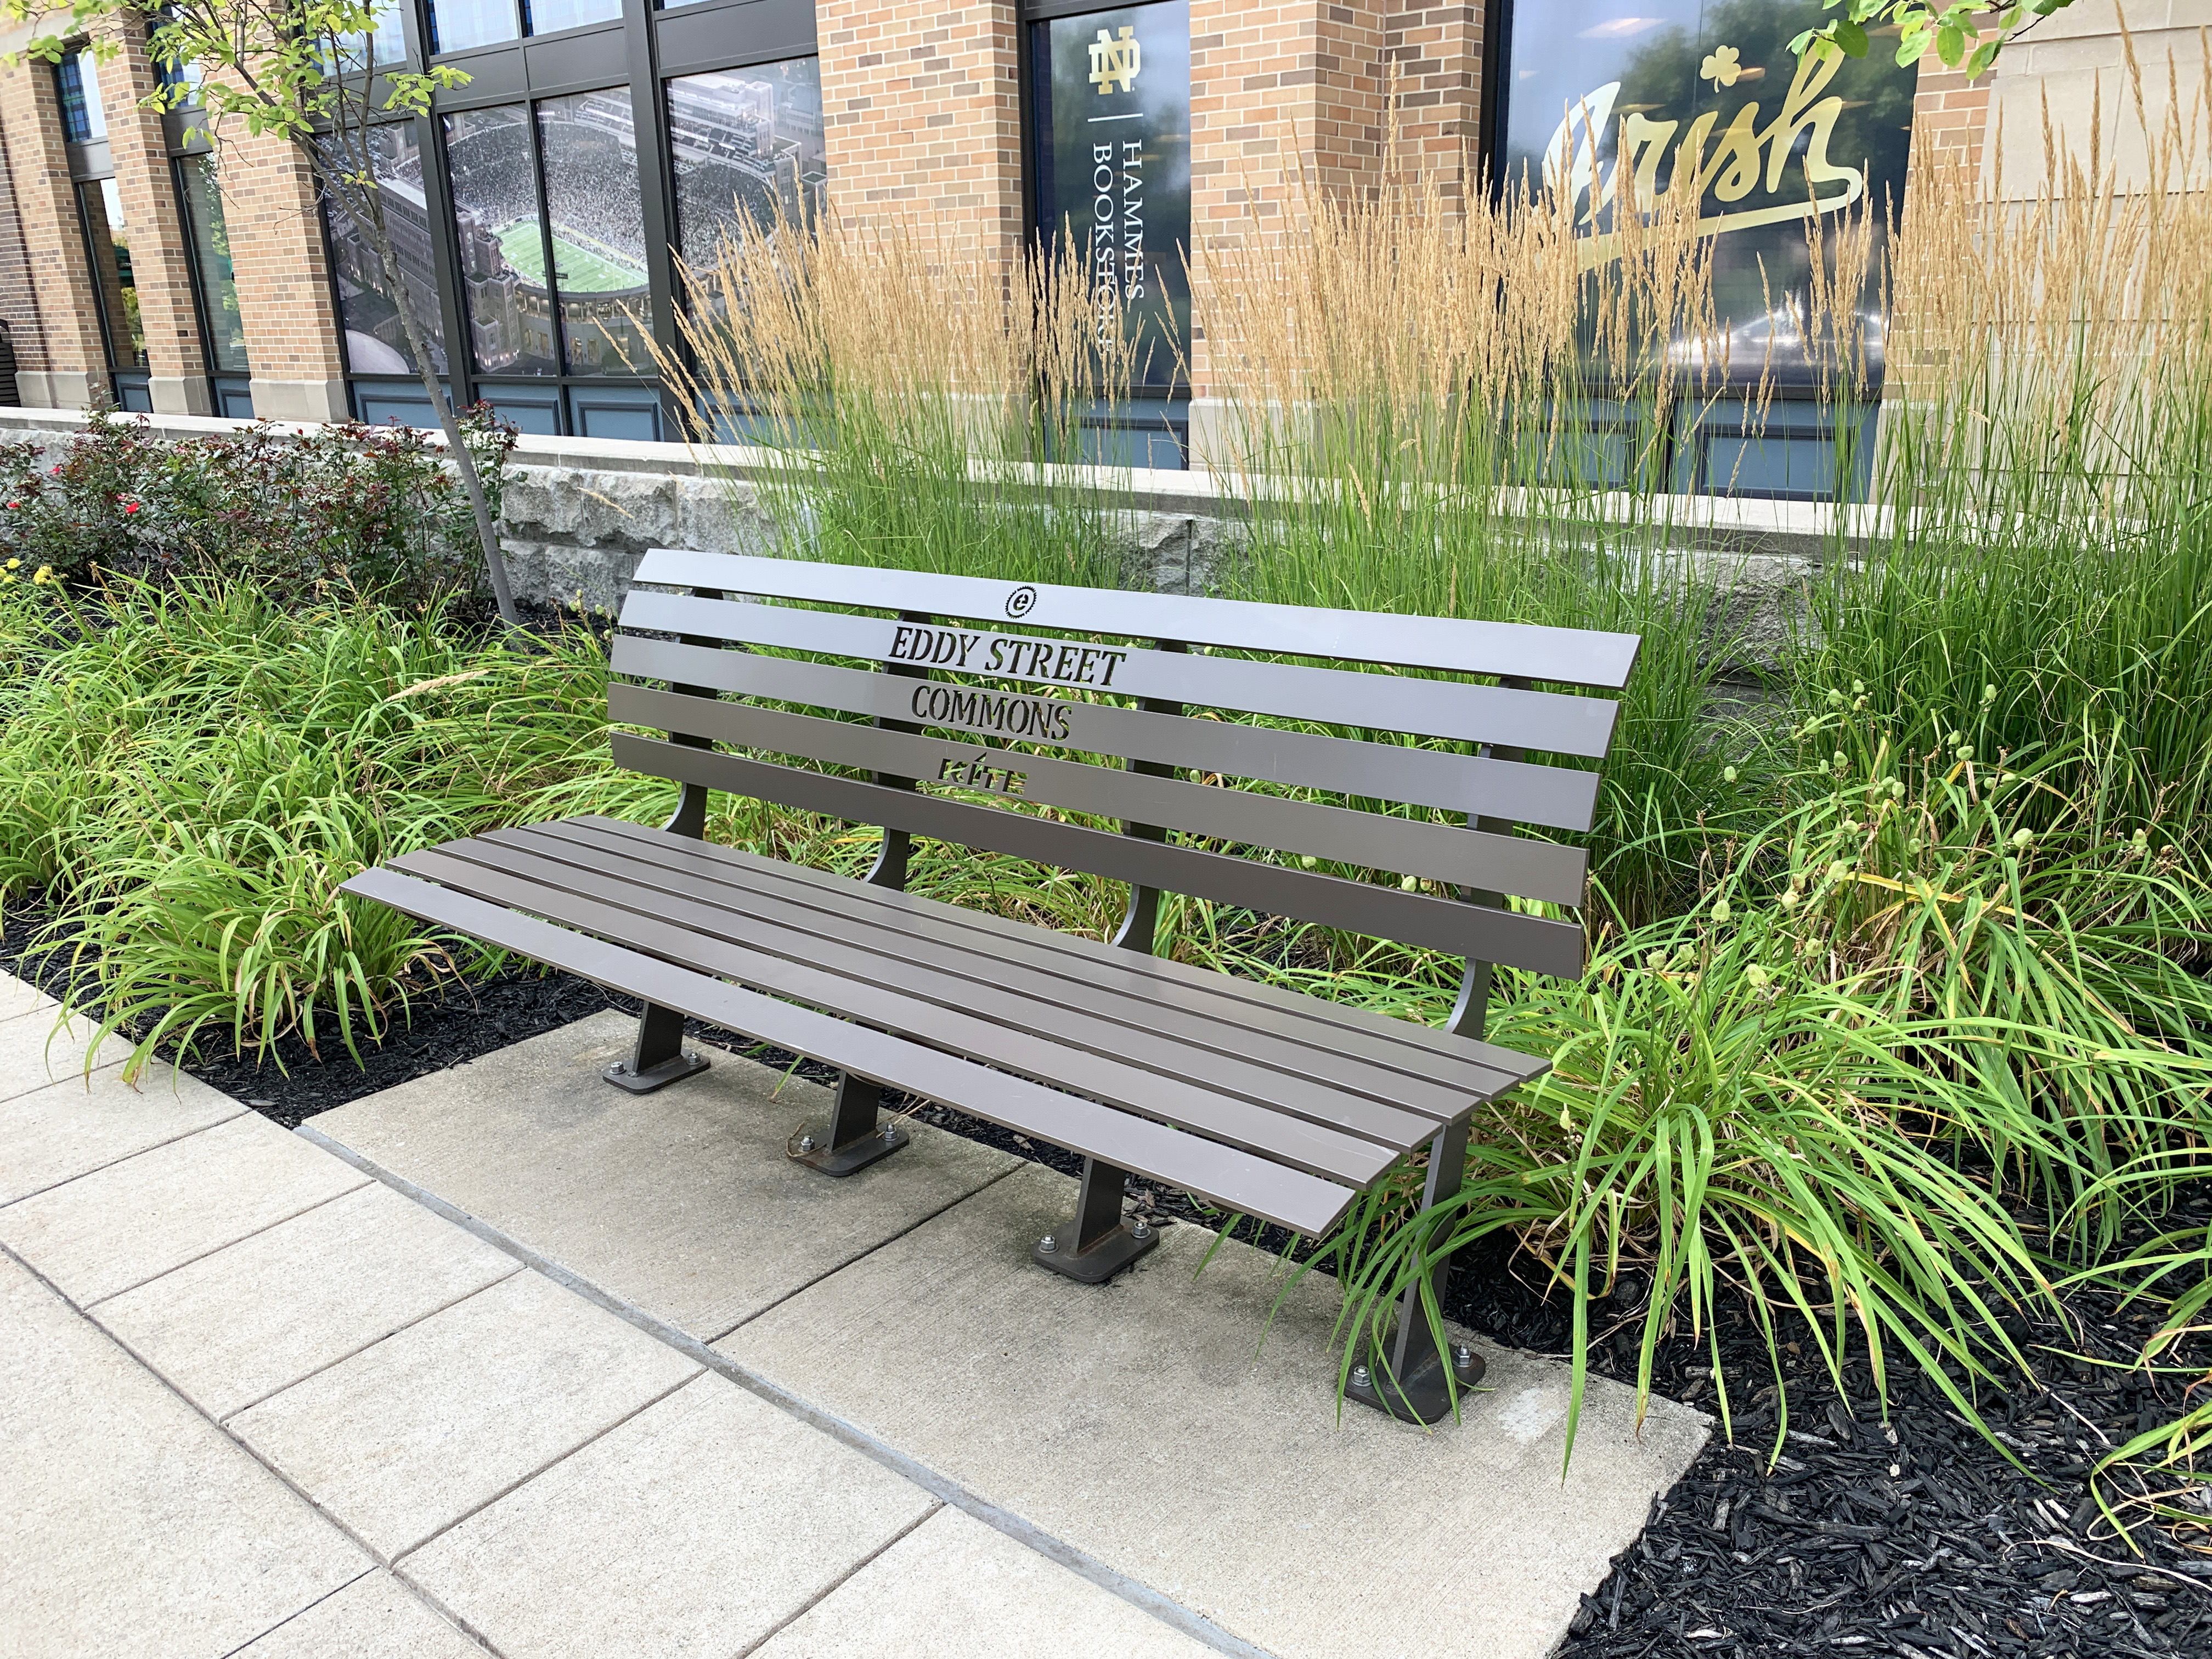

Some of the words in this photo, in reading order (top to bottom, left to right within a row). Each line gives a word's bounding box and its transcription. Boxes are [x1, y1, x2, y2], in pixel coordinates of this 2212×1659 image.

[1535, 40, 1863, 266] Irish
[1122, 139, 1144, 300] HAMMES
[888, 626, 980, 667] EDDY
[985, 638, 1127, 686] STREET
[911, 685, 1072, 741] COMMONS
